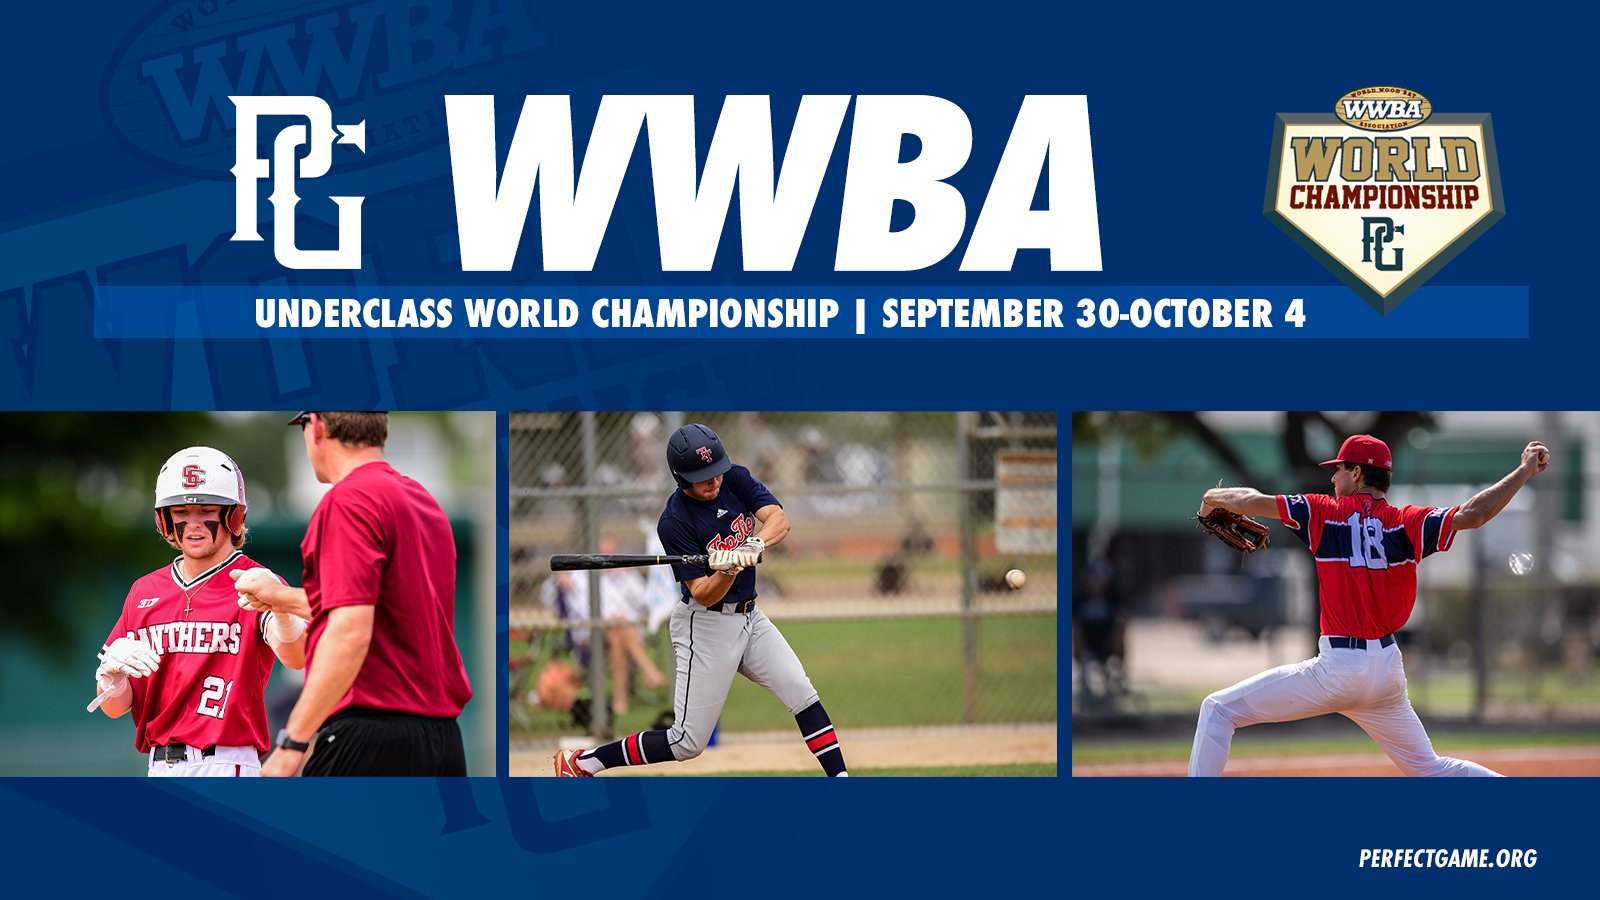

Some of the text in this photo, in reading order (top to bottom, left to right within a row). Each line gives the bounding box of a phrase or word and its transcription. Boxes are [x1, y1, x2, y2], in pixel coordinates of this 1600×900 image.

[731, 512, 756, 542] Tie
[1347, 511, 1389, 570] 18
[196, 674, 233, 720] 21
